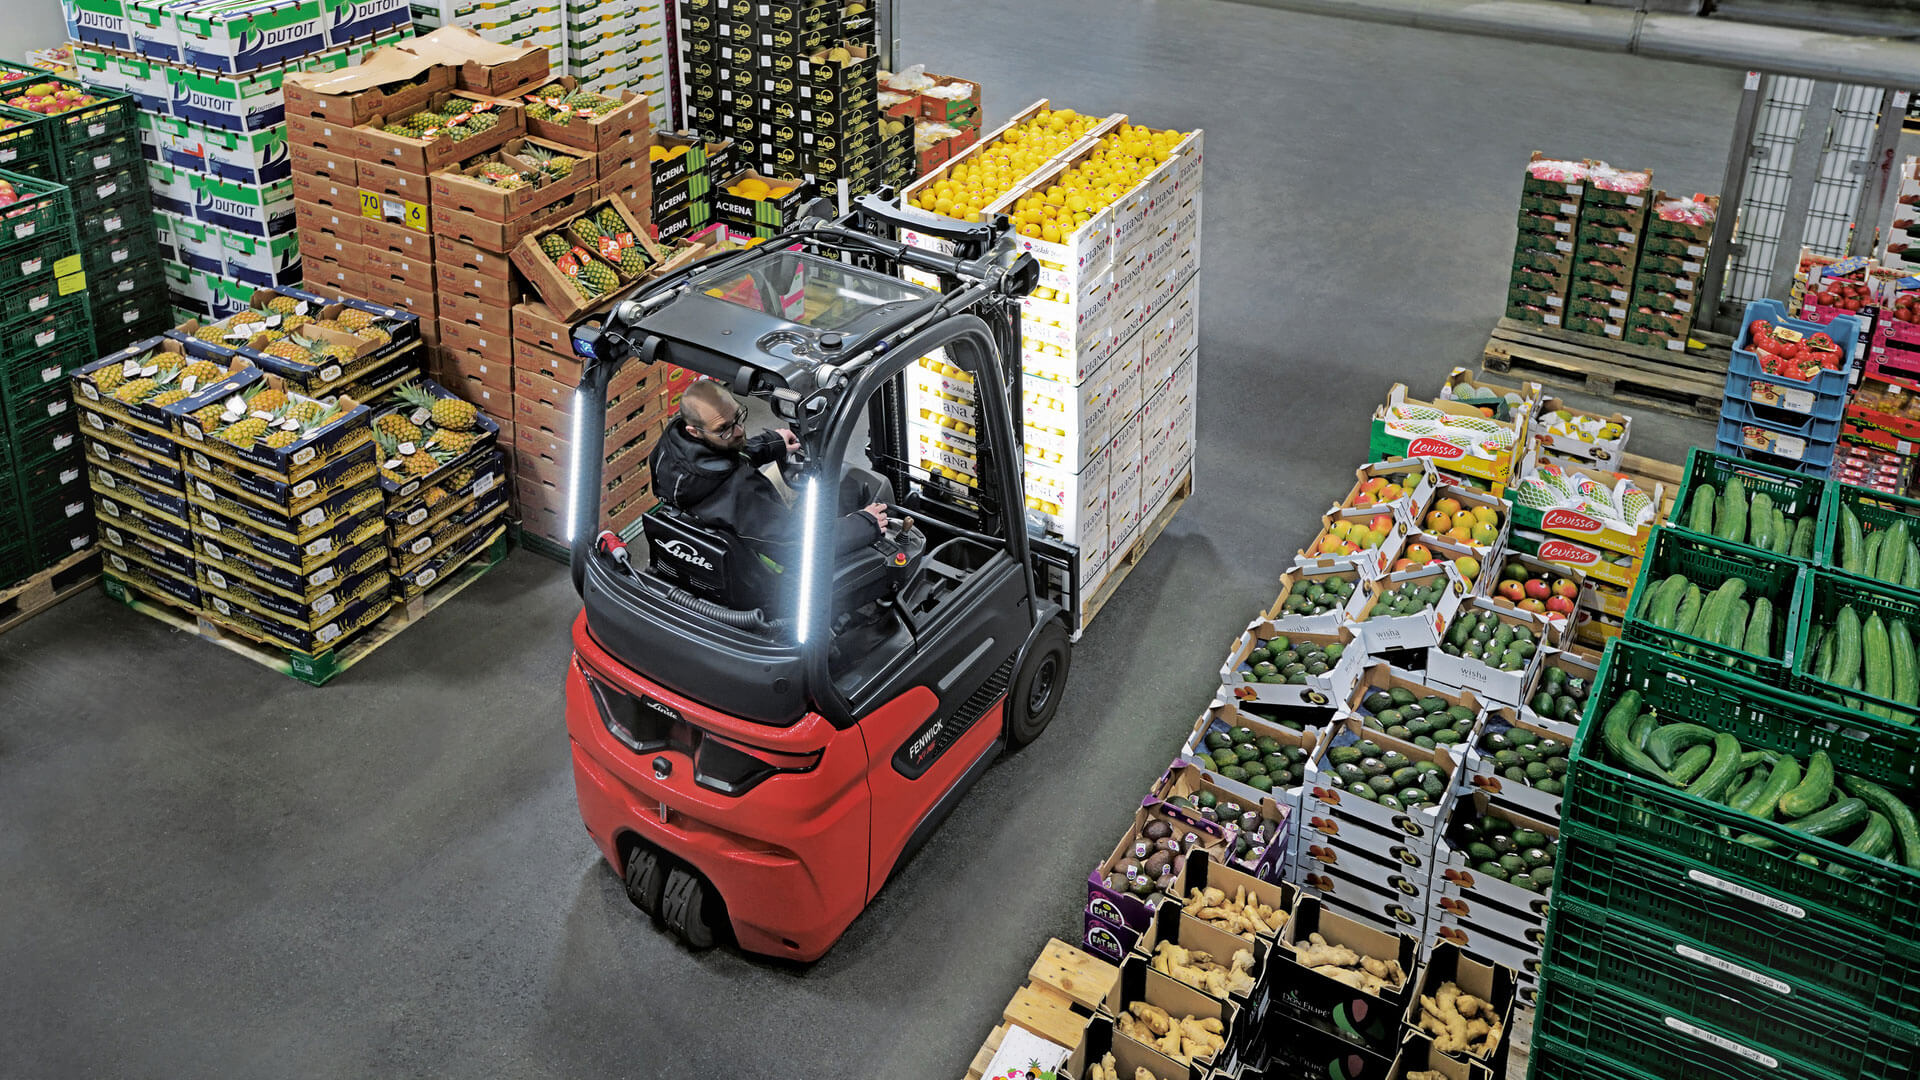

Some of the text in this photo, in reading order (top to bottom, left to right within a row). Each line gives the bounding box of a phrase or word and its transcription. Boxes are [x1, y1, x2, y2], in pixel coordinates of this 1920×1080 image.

[84, 12, 123, 31] DUTOIT
[267, 21, 315, 45] DUTOIT
[192, 93, 233, 112] DUTOIT
[710, 153, 729, 168] ACRENA
[655, 164, 685, 185] ACRENA
[215, 200, 256, 217] DUTOIT
[362, 194, 378, 210] 70
[658, 192, 687, 213] ACRENA
[716, 200, 752, 217] ACRENA
[412, 207, 421, 220] 6
[658, 218, 688, 240] ACRENA
[1412, 440, 1457, 456] Levissa
[1461, 464, 1496, 477] FORMOSA
[1547, 512, 1595, 528] Levissa
[1542, 544, 1590, 560] Levissa
[1600, 538, 1636, 552] FORMOSA
[655, 539, 714, 571] Linde
[1376, 630, 1400, 638] wisha
[1460, 667, 1487, 680] wisha
[647, 702, 678, 720] Linde
[910, 718, 943, 759] FENWICK
[1094, 906, 1120, 922] EAT ME
[1092, 934, 1118, 951] EAT ME
